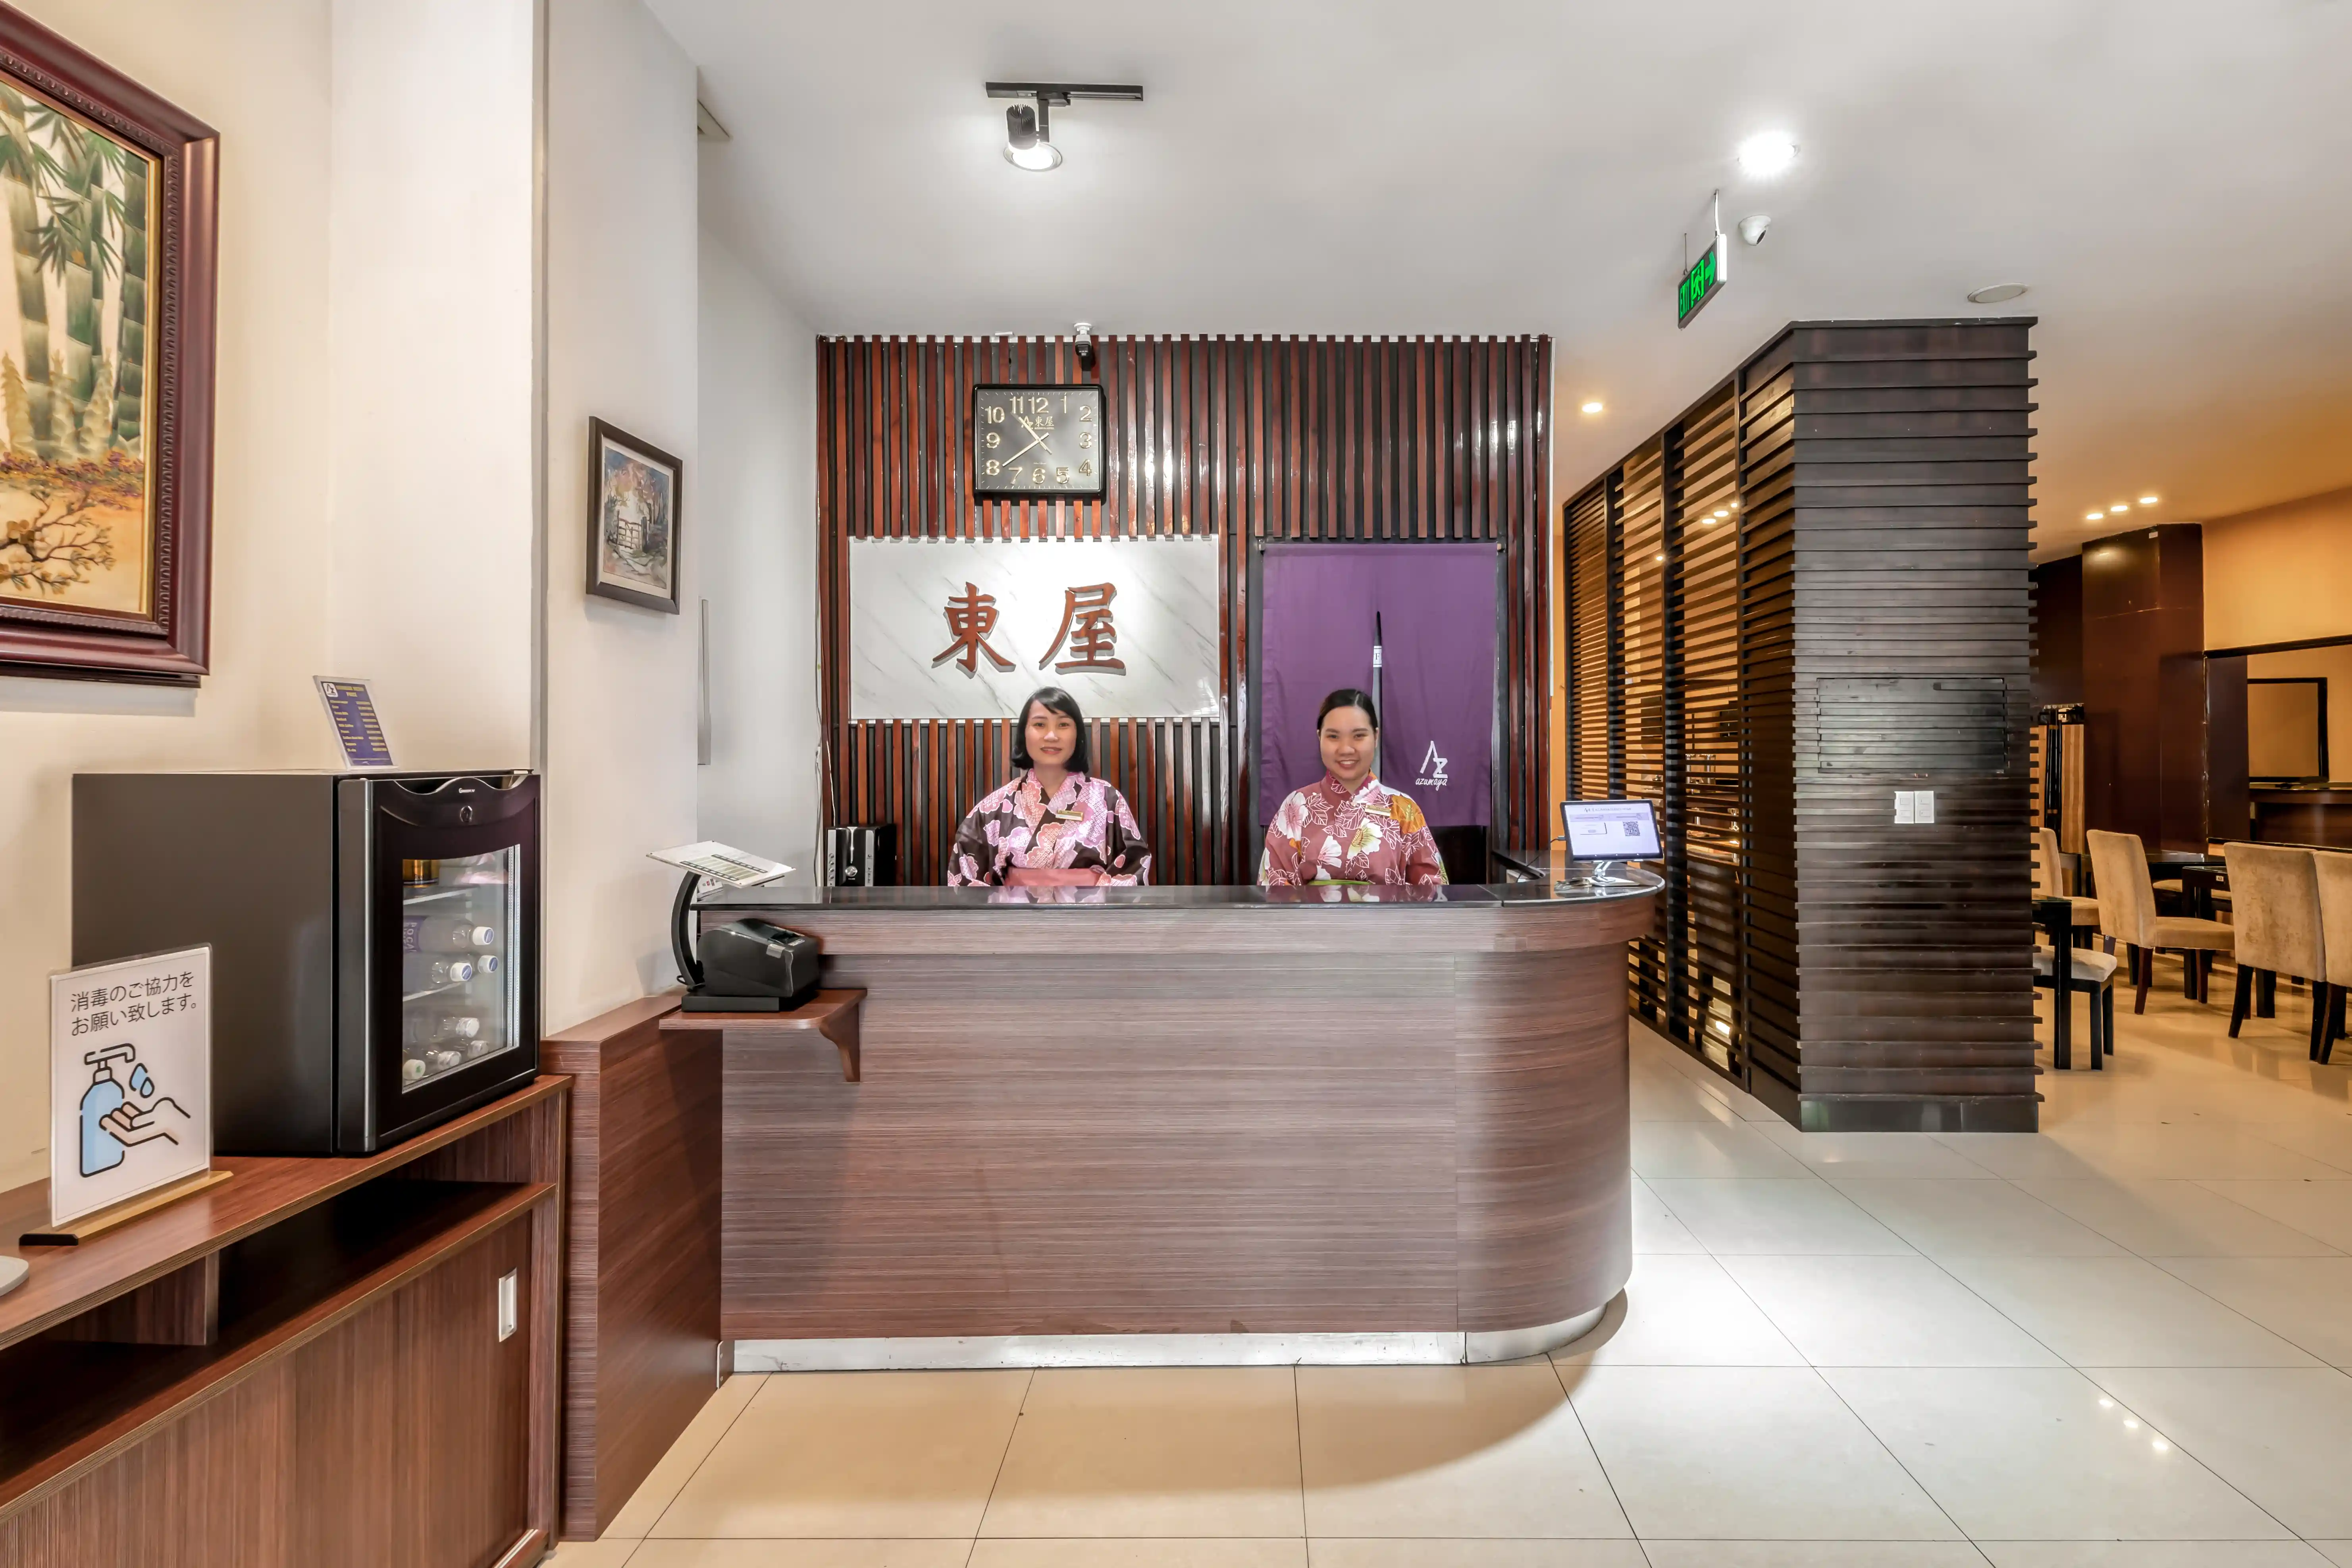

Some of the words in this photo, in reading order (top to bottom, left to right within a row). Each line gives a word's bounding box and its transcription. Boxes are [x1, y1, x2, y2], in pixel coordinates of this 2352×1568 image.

[1680, 279, 1690, 318] EXIT
[1009, 396, 1023, 414] 11
[1028, 397, 1049, 414] 12
[1060, 395, 1067, 413] 1
[985, 406, 1005, 424] 10
[1079, 405, 1092, 422] 2
[986, 432, 1000, 449] 9
[1079, 432, 1092, 449] 3
[986, 459, 1000, 476] 8
[1008, 467, 1023, 484] 7
[1032, 467, 1046, 484] 6
[1056, 467, 1070, 484] 5
[1079, 459, 1093, 476] 4
[1415, 778, 1448, 791] azumaya
[71, 971, 194, 1012] 消毒のご協力を
[71, 993, 196, 1036] お願い致します。
